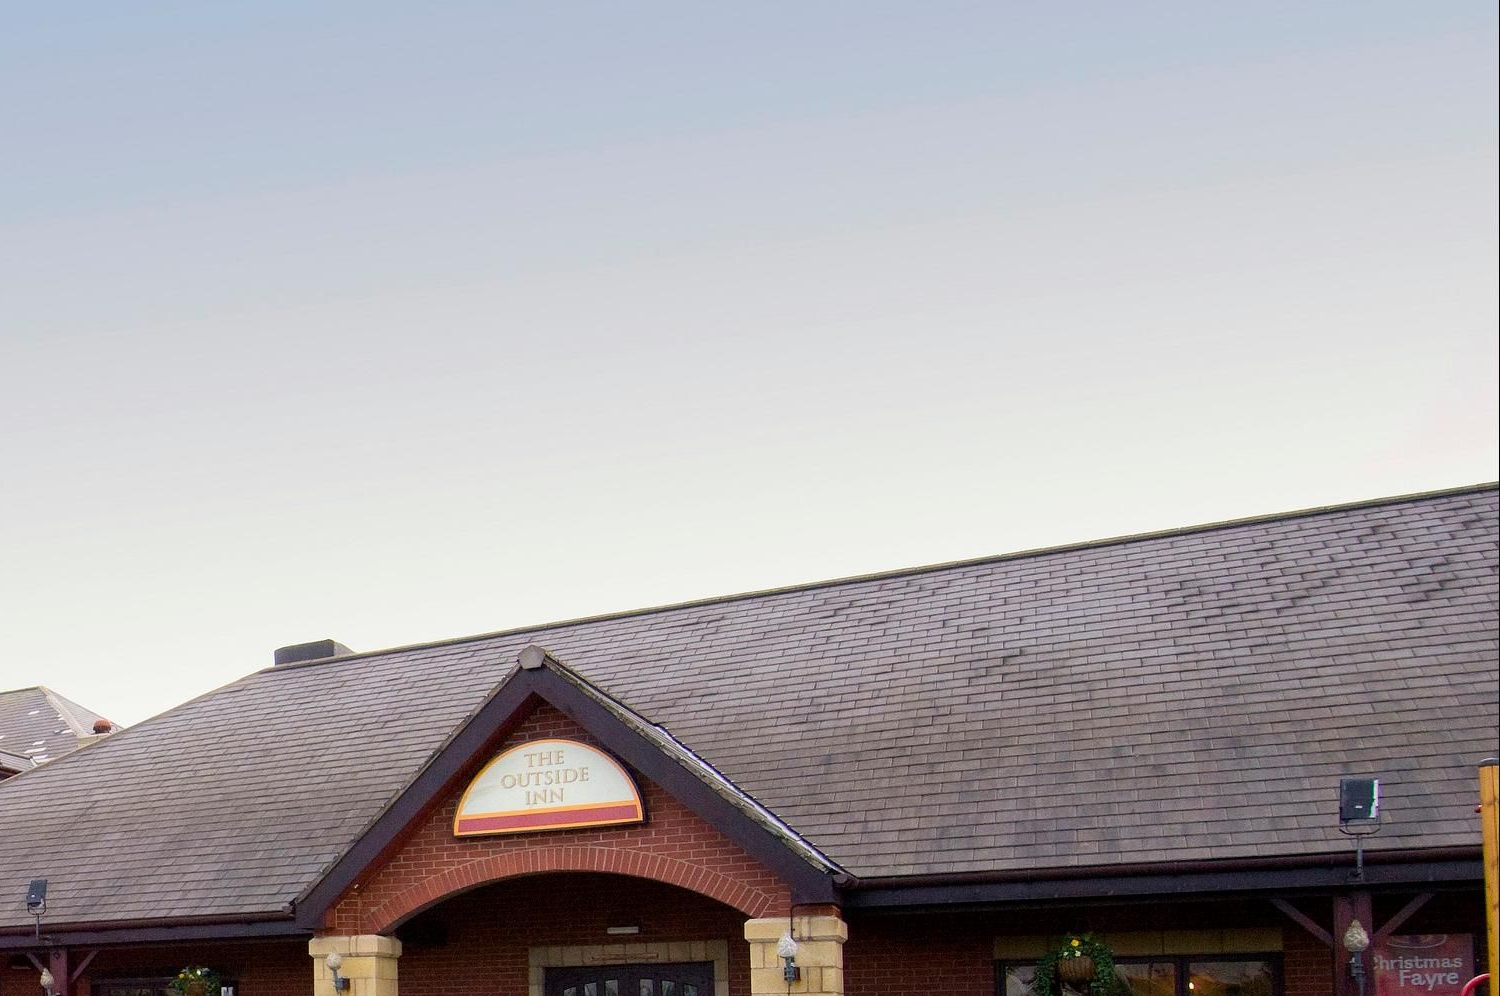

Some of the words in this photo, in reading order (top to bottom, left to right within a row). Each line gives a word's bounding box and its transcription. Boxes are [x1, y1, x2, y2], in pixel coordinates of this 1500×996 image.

[523, 750, 564, 768] THE
[501, 766, 589, 789] OUTSIDE
[525, 788, 564, 806] INN
[1400, 970, 1460, 991] Fayre
